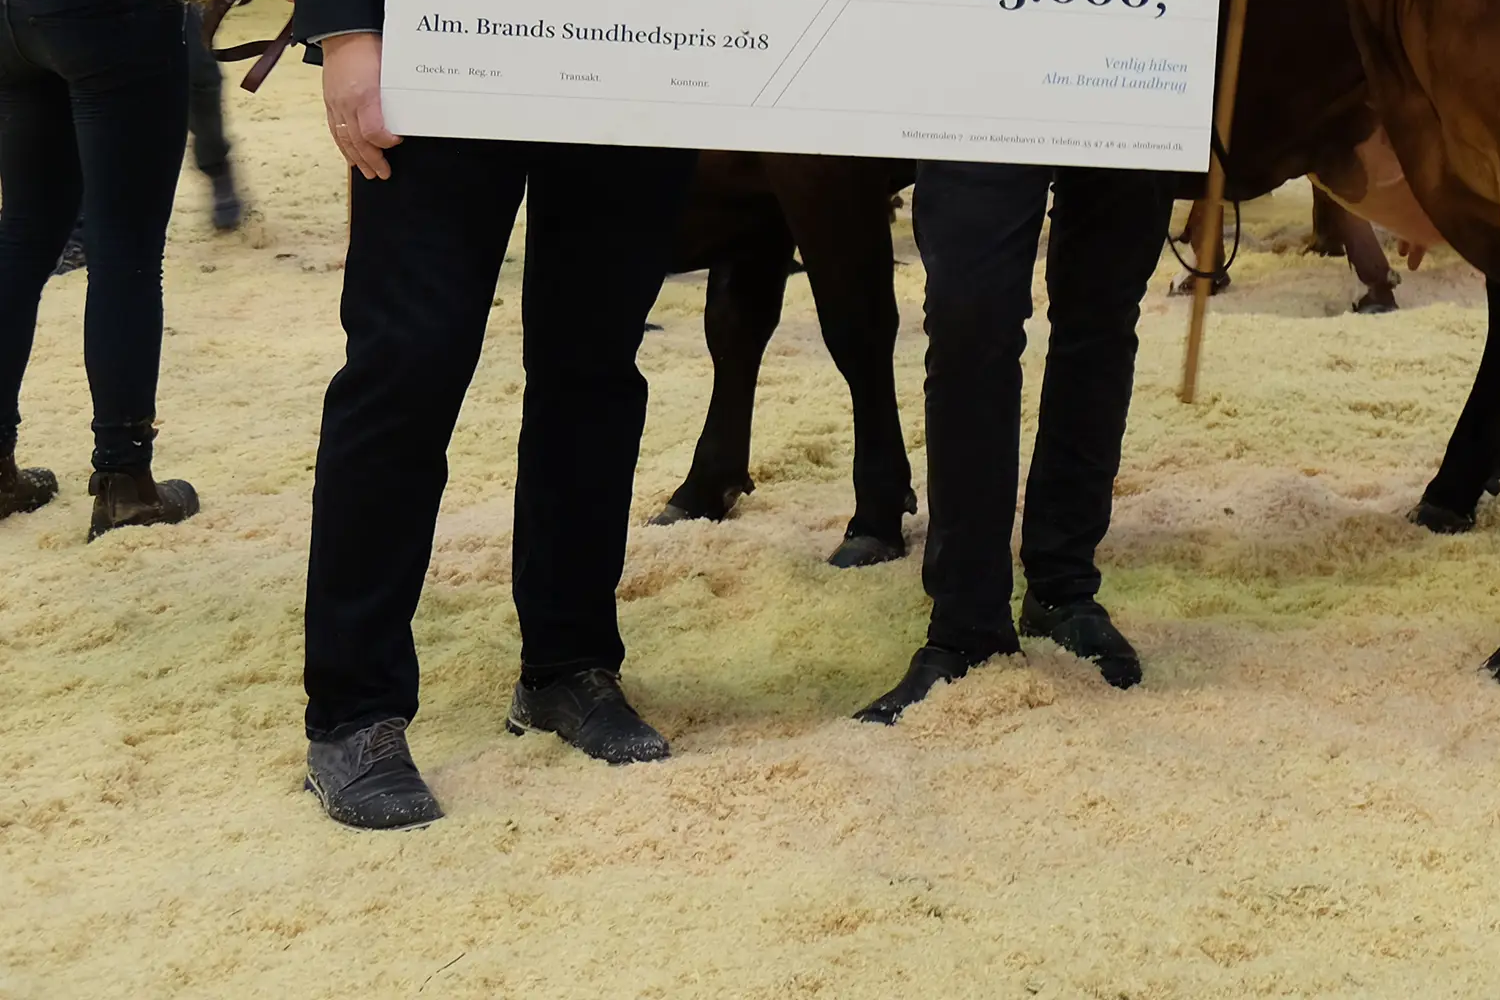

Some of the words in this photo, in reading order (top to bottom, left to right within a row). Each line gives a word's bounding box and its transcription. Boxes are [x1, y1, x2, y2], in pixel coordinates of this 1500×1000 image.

[416, 13, 469, 34] Alm.
[476, 17, 556, 39] Brands
[562, 22, 717, 50] Sundhedspris
[722, 32, 770, 51] 2018
[415, 64, 445, 75] Check
[447, 67, 461, 75] nr.
[468, 67, 488, 78] Reg.
[490, 69, 503, 78] nr.
[560, 72, 602, 83] Transakt.
[670, 78, 710, 88] Kontonr.
[1105, 56, 1146, 74] Venlig
[1149, 58, 1188, 73] hilsen
[1042, 72, 1073, 85] Alm.
[1076, 74, 1119, 88] Brand
[1121, 76, 1188, 94] Landbrug
[902, 130, 957, 141] Midtermolen
